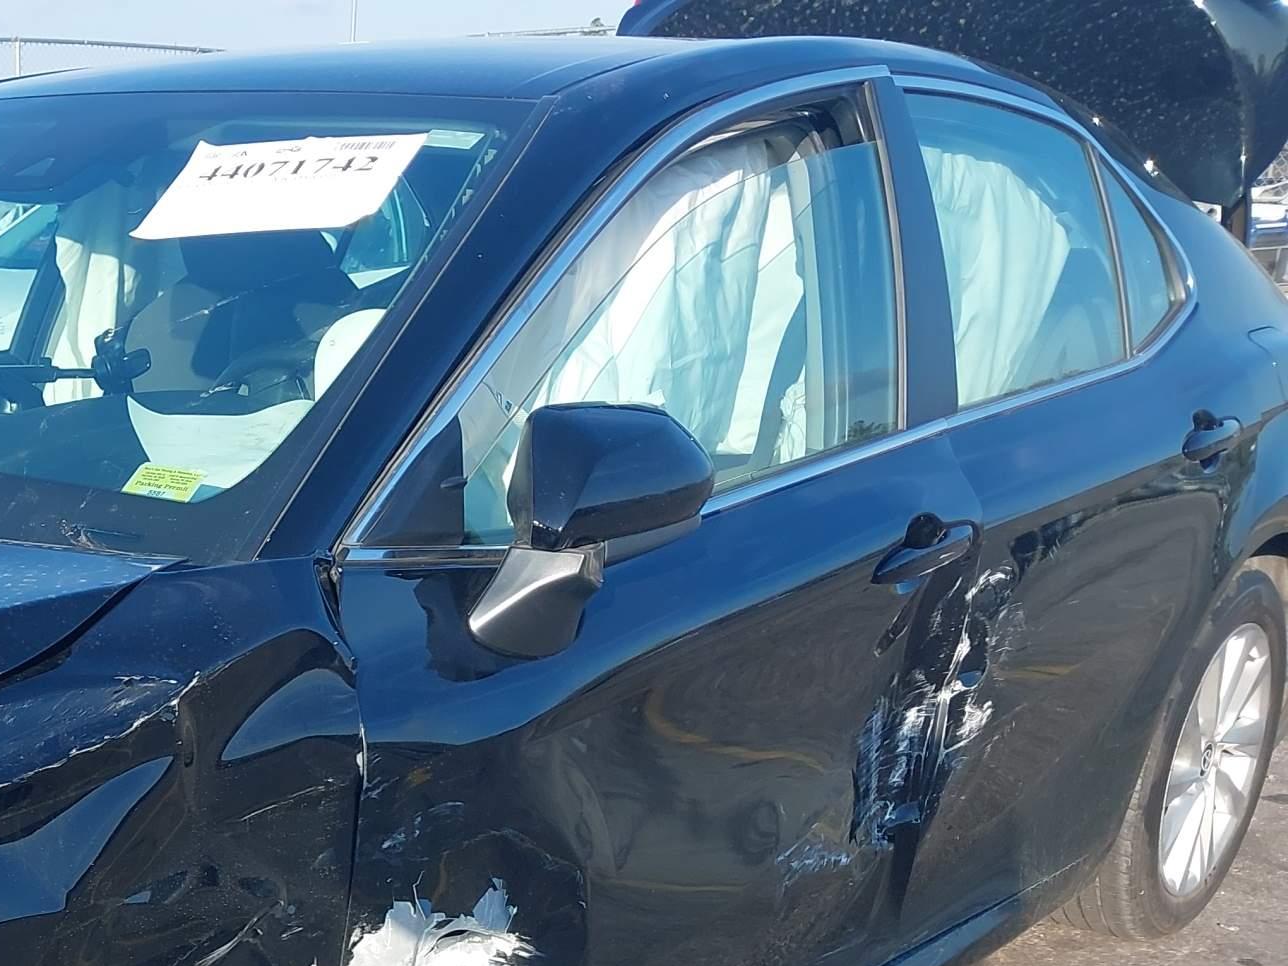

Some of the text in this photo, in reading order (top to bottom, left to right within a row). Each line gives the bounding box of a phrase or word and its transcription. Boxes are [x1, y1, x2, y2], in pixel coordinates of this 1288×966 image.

[199, 156, 378, 181] 44071742
[134, 480, 163, 489] Parking
[164, 483, 189, 492] Permit
